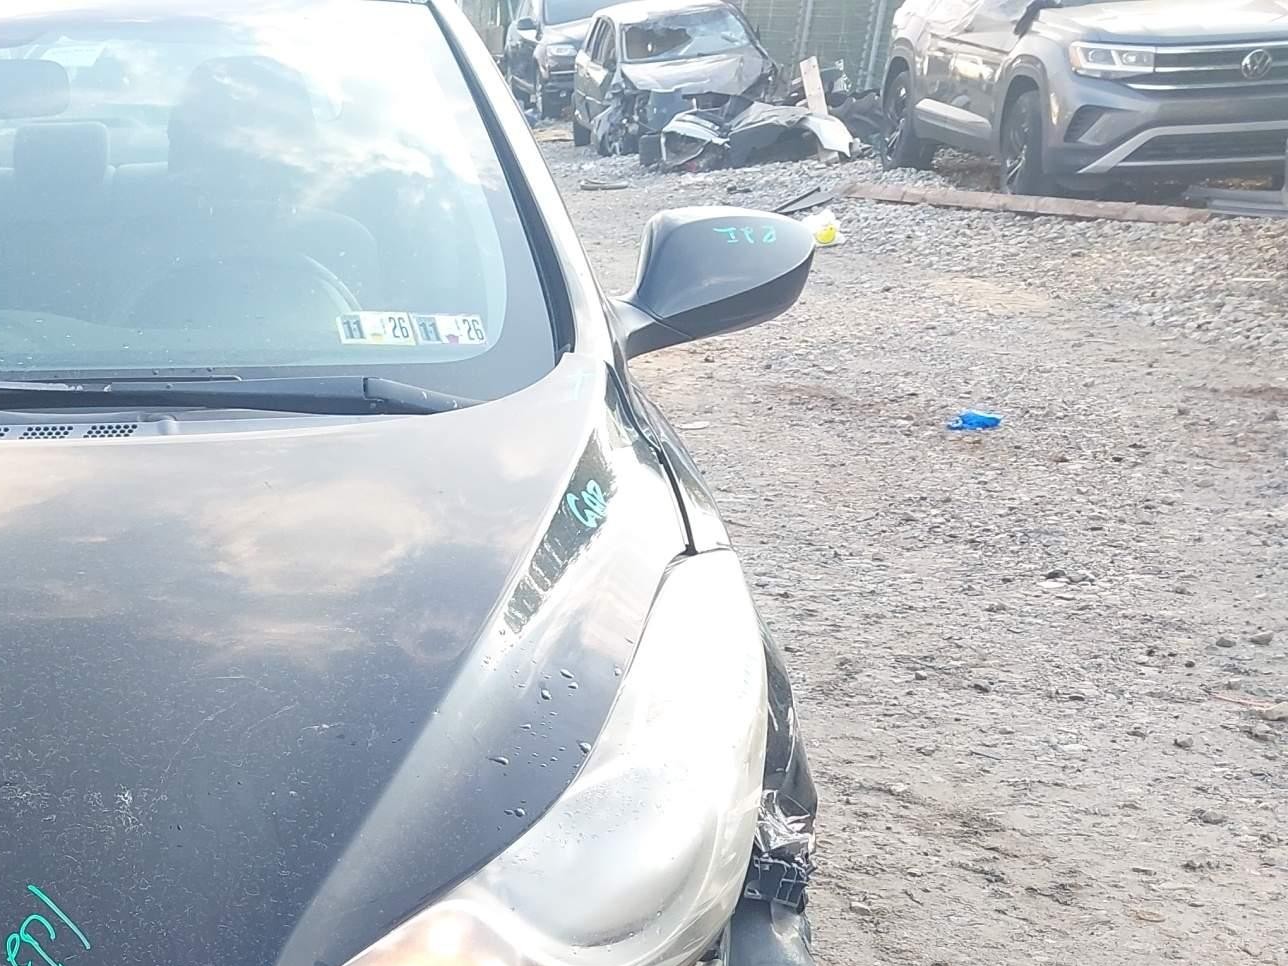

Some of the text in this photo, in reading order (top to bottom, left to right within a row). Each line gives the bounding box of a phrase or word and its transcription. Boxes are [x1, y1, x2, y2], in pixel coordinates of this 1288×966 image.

[342, 319, 365, 340] 11
[388, 316, 410, 339] 26
[418, 321, 443, 342] 11
[462, 318, 485, 341] 26
